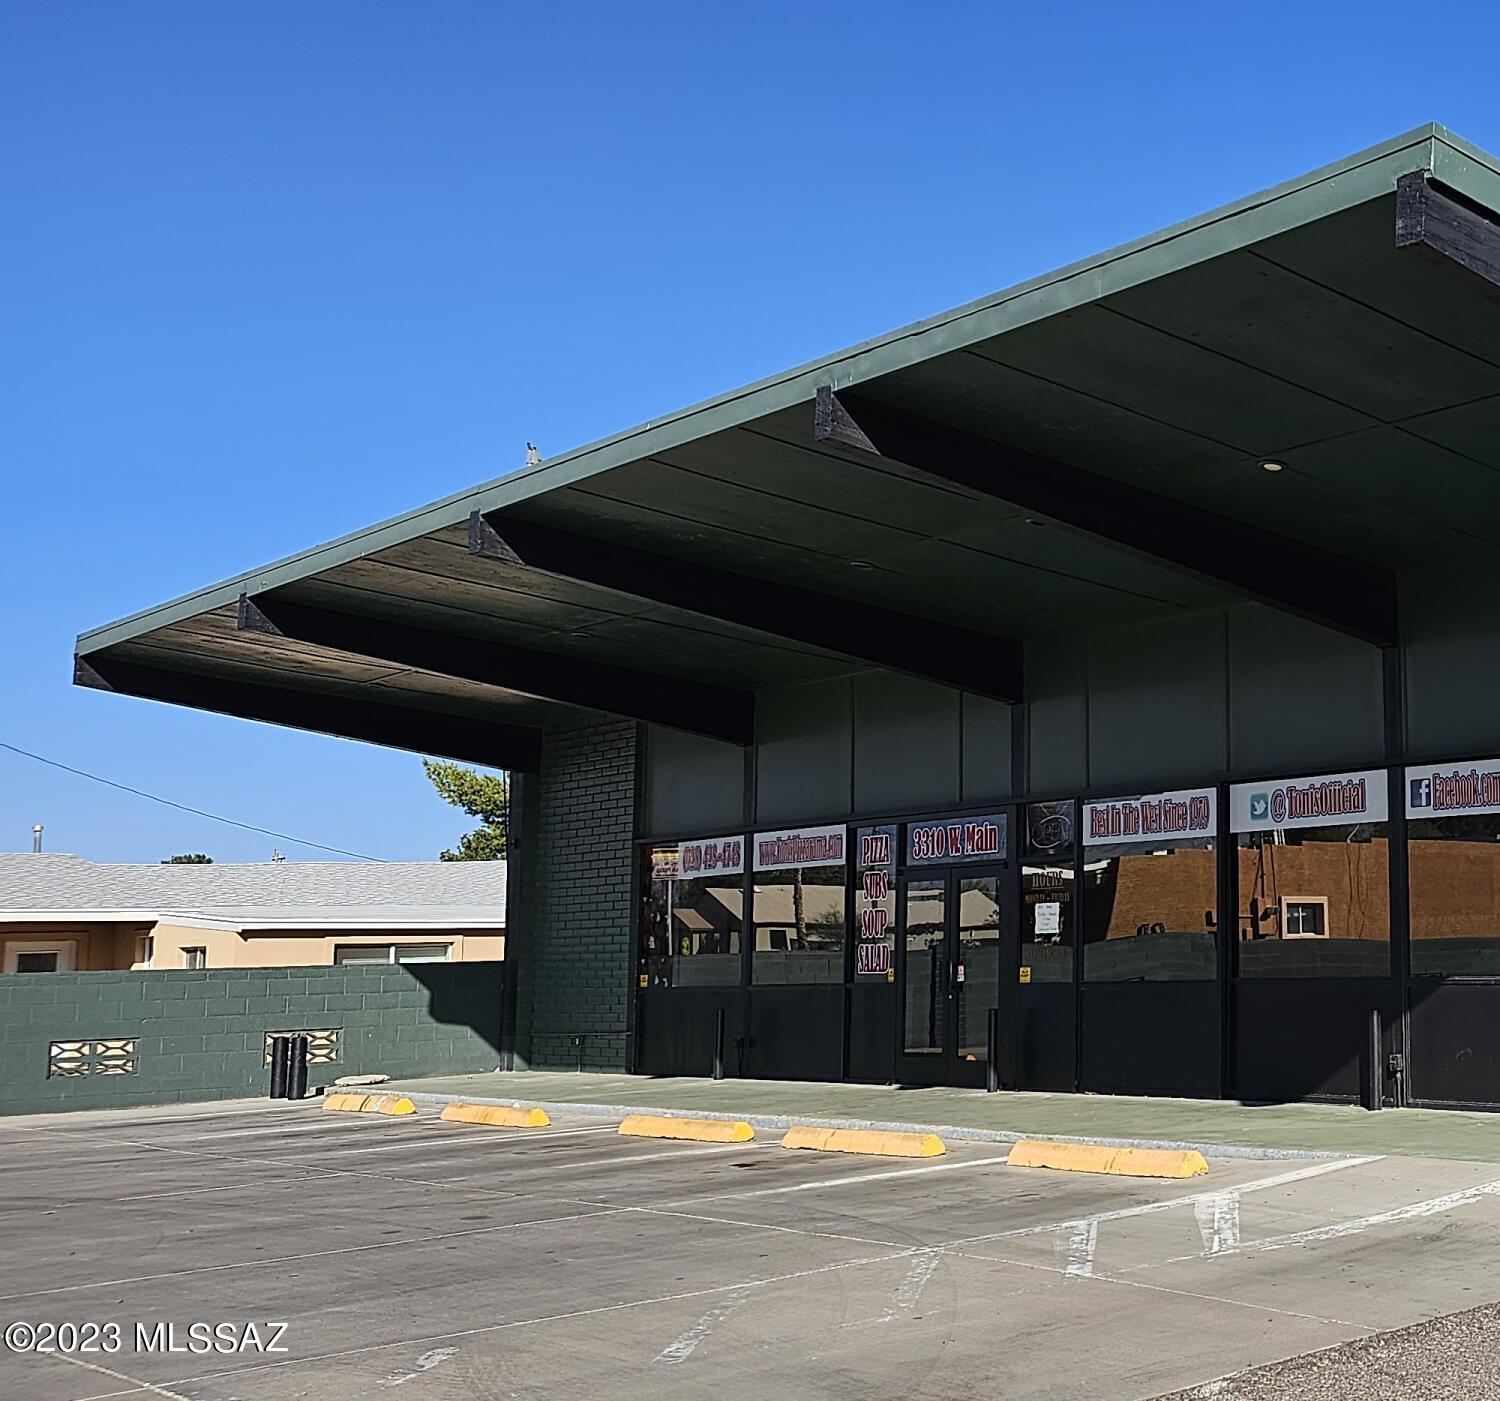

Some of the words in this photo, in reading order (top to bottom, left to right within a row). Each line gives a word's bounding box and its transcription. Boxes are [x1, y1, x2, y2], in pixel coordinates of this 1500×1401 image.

[1090, 804, 1109, 838] Best
[1110, 804, 1121, 836] In
[1122, 802, 1140, 836] The
[1140, 800, 1162, 834] West
[1162, 798, 1188, 832] Since
[1188, 795, 1210, 831] 1979
[862, 834, 890, 866] PIZZA
[913, 826, 945, 859] 3310
[947, 825, 961, 856] W.
[964, 822, 998, 854] Main
[863, 870, 889, 901] SUBS
[1032, 871, 1063, 887] HOURS
[861, 908, 888, 938] SOUP
[857, 943, 890, 974] SALAD
